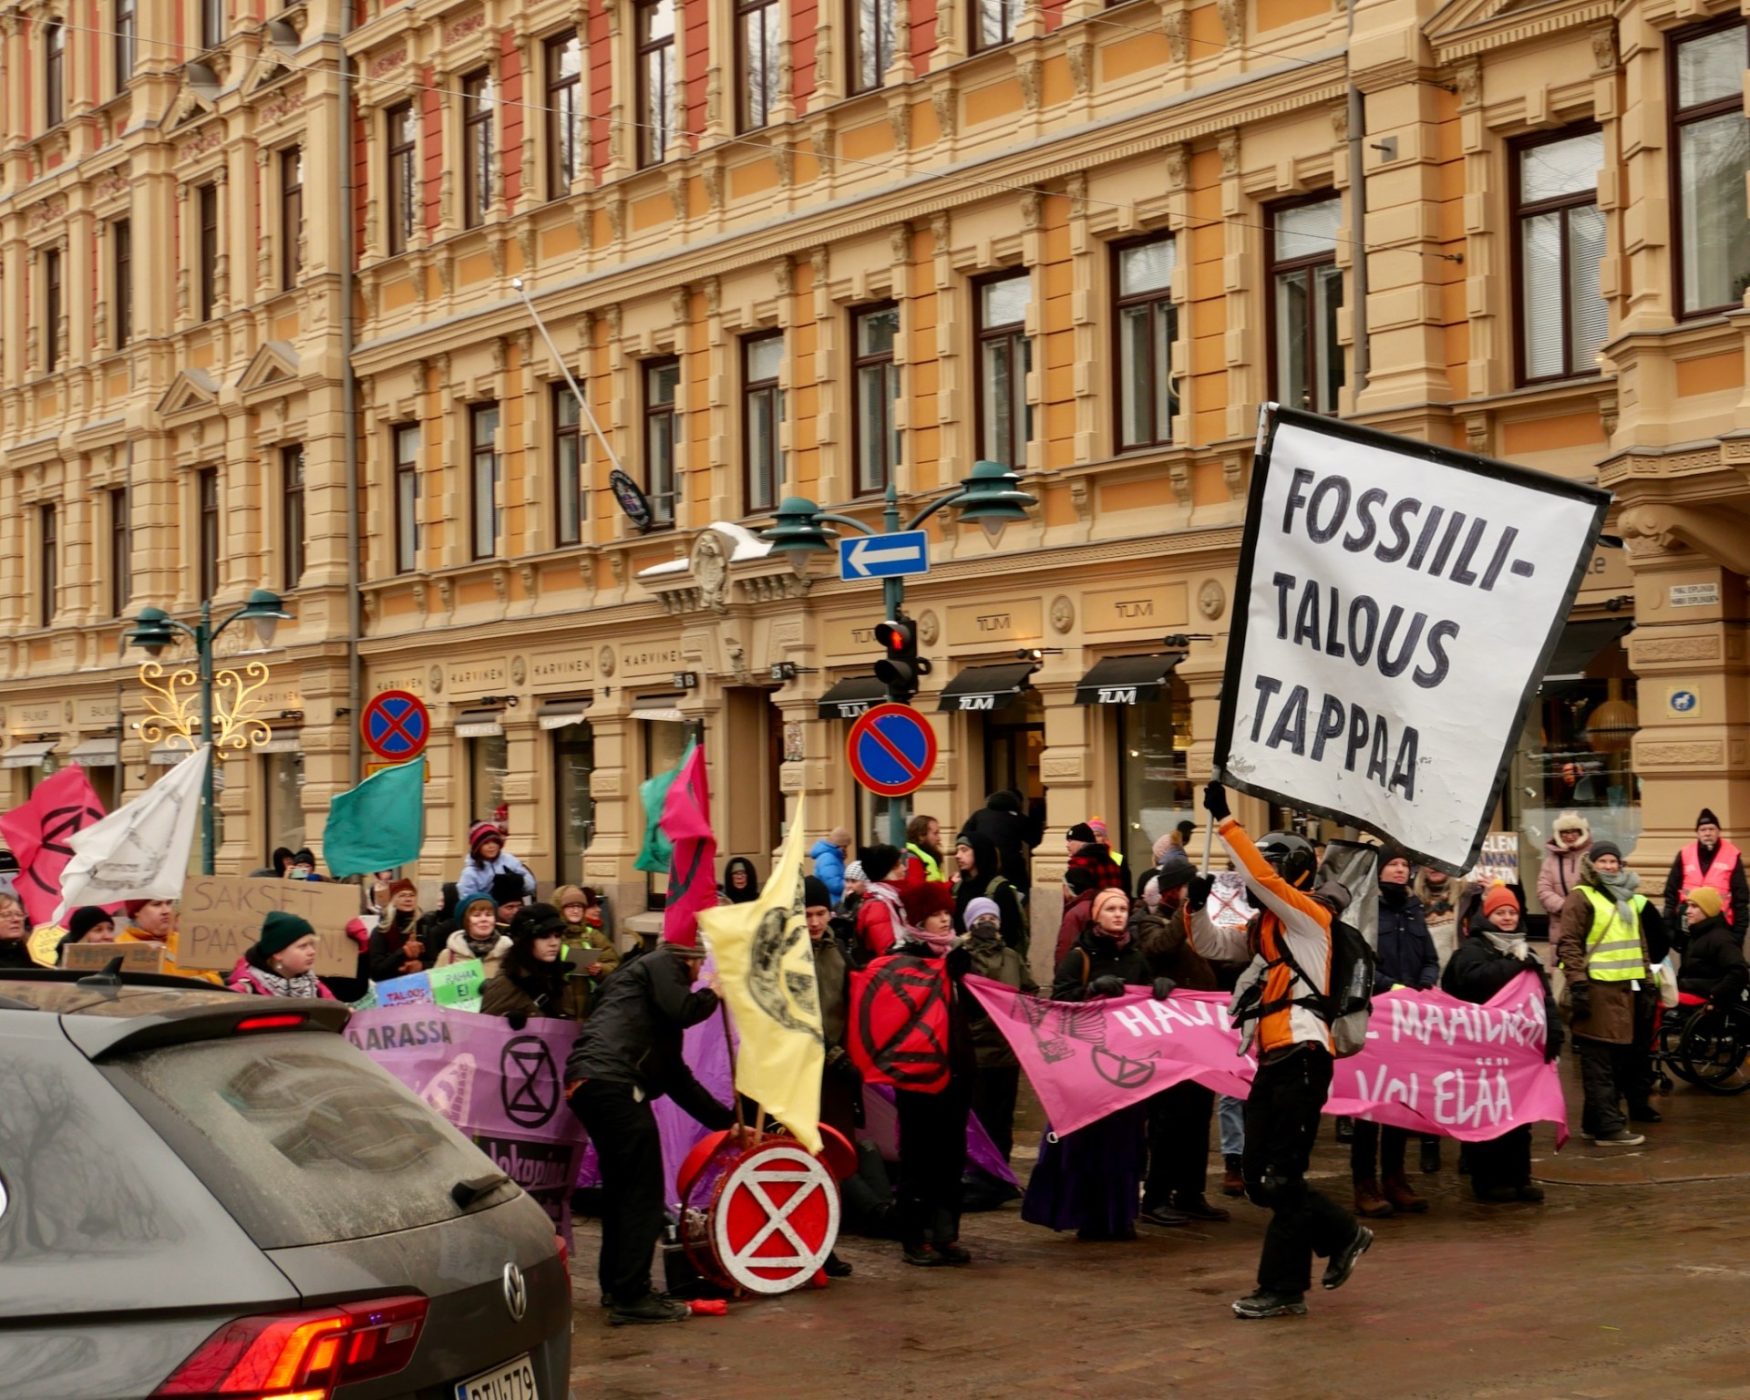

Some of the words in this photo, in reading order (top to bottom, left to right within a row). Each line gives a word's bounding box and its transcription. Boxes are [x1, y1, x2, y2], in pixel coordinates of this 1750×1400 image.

[1282, 467, 1535, 591] FOSSIILI-
[1273, 571, 1460, 689] TALOUS
[958, 695, 995, 710] TUMI
[1098, 687, 1137, 704] TUMI
[1250, 674, 1419, 801] TAPPAA
[347, 1020, 453, 1051] AARASSA
[1433, 1057, 1514, 1128] ELÄÄ
